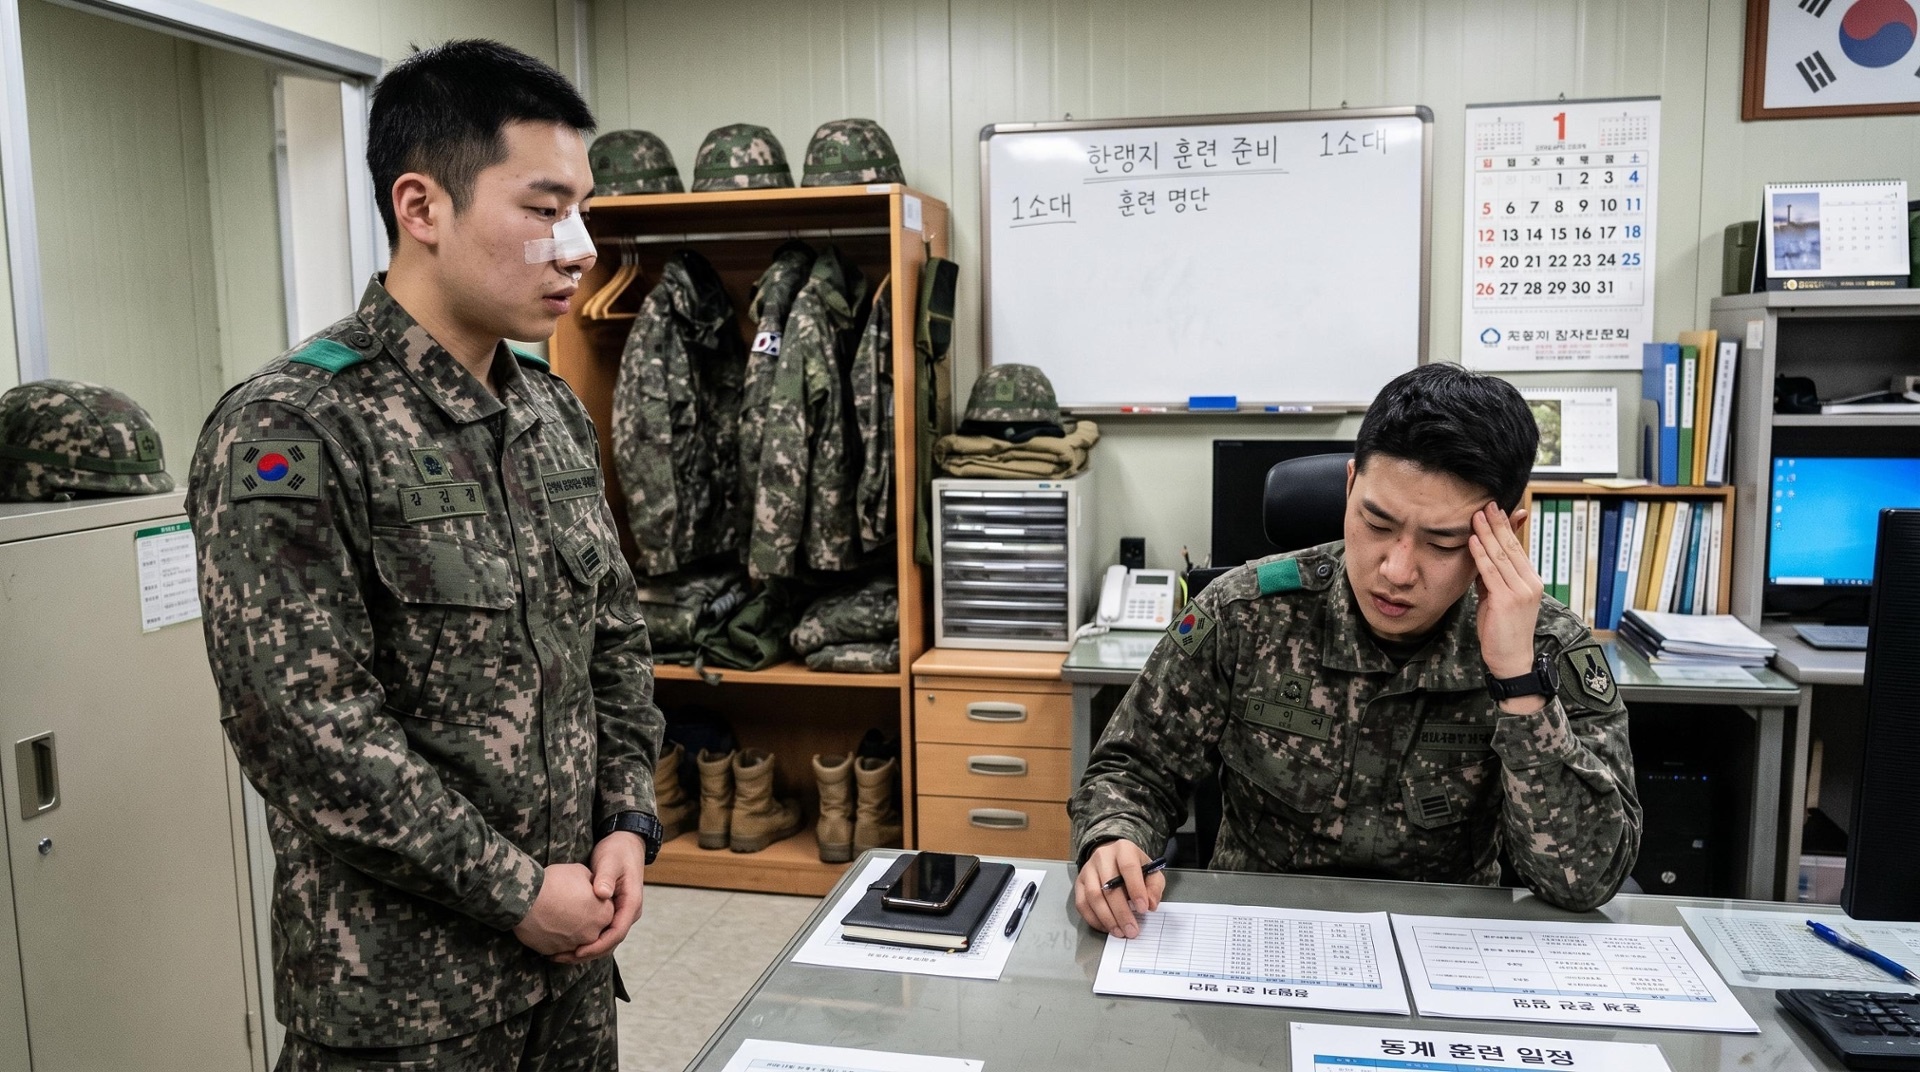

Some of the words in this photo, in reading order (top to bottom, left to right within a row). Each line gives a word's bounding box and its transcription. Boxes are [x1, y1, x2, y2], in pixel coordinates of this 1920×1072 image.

[1553, 112, 1566, 141] 1
[1087, 140, 1159, 175] 한랭지
[1173, 137, 1217, 170] 훈련
[1231, 134, 1277, 166] 준비
[1319, 128, 1387, 158] 1소대
[1557, 172, 1563, 186] 1
[1579, 171, 1589, 185] 2
[1604, 170, 1614, 184] 3
[1628, 169, 1640, 183] 4
[1011, 193, 1071, 221] 1소대
[1117, 189, 1156, 218] 훈련
[1168, 186, 1211, 214] 명단
[1482, 202, 1492, 215] 5
[1505, 201, 1516, 215] 6
[1530, 200, 1540, 214] 7
[1554, 199, 1564, 214] 8
[1578, 199, 1589, 213] 9
[1600, 198, 1618, 212] 10
[1626, 197, 1641, 211] 11
[1478, 229, 1495, 242] 12
[1502, 228, 1519, 242] 13
[1526, 228, 1543, 241] 14
[1550, 227, 1568, 241] 15
[1574, 226, 1592, 240] 16
[1599, 225, 1617, 240] 17
[1624, 224, 1642, 239] 18
[1478, 255, 1495, 269] 19
[1499, 255, 1520, 269] 20
[1524, 254, 1541, 268] 21
[1548, 254, 1568, 268] 22
[1572, 253, 1592, 267] 23
[1597, 253, 1617, 267] 24
[1621, 252, 1641, 266] 25
[1476, 282, 1495, 296] 26
[1499, 281, 1519, 296] 27
[1523, 281, 1543, 295] 28
[1547, 281, 1567, 295] 29
[1571, 280, 1591, 295] 30
[1596, 280, 1614, 294] 31
[1380, 1039, 1436, 1058] 동계
[1448, 1043, 1505, 1062] 훈련
[1516, 1047, 1575, 1066] 일정
